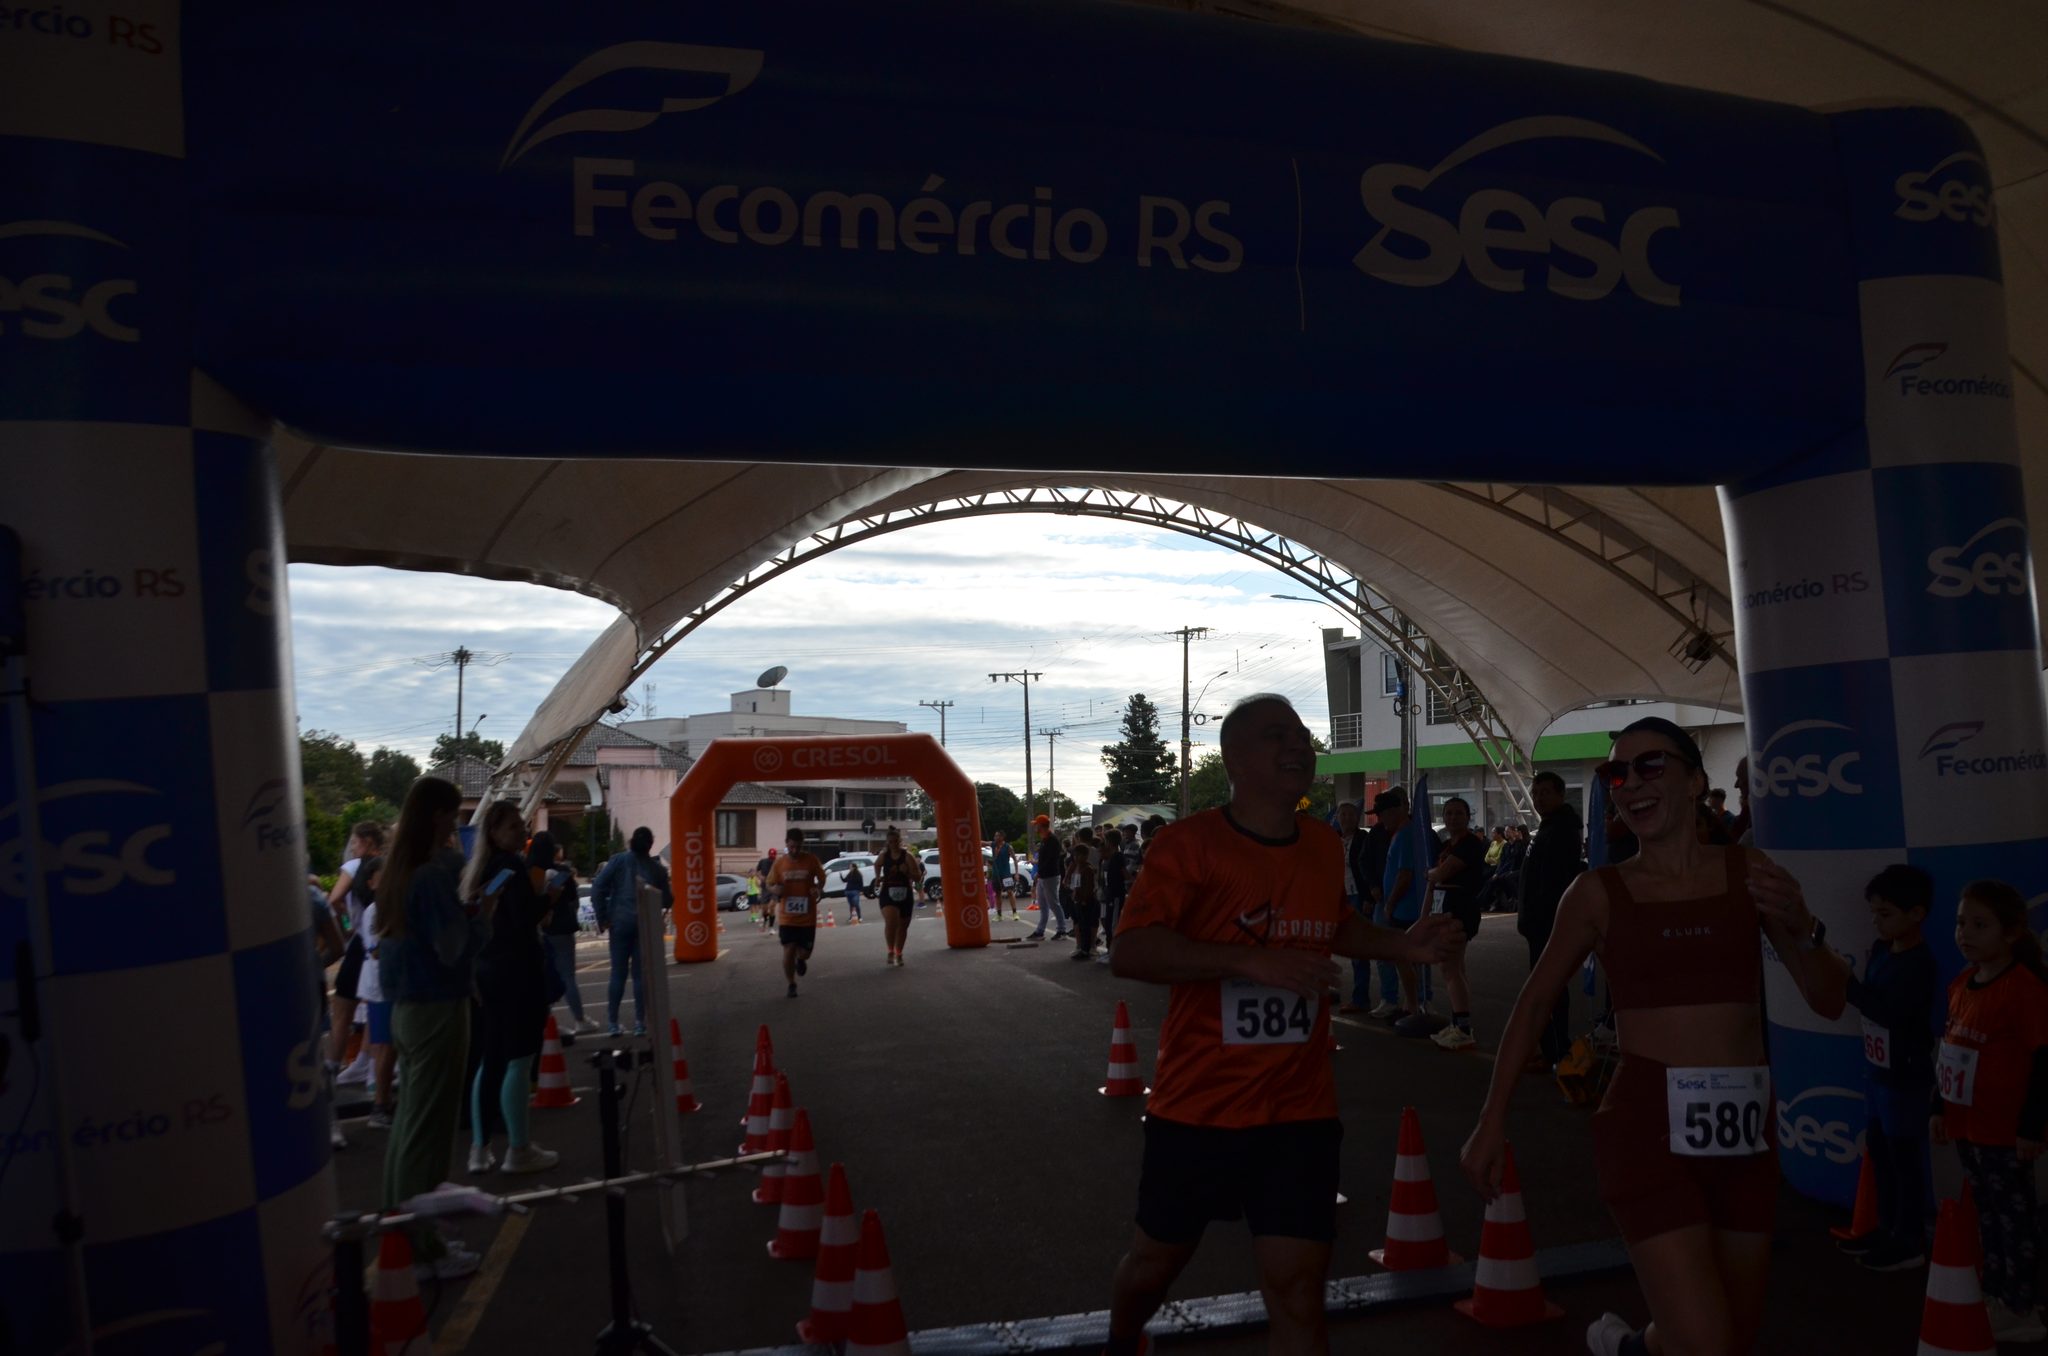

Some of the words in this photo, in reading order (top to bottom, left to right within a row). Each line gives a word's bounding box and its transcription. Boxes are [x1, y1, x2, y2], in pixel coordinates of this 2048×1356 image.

[110, 15, 162, 54] RS
[573, 157, 1108, 264] Fecomércio
[1138, 195, 1244, 273] RS
[1352, 162, 1682, 308] Sesc
[134, 568, 186, 598] RS
[1832, 571, 1869, 595] RS
[791, 744, 899, 769] CRESOL
[684, 824, 705, 915] CRESOL
[954, 810, 978, 898] CRESOL
[1236, 997, 1311, 1039] 584
[183, 1093, 234, 1131] RS
[1685, 1100, 1761, 1149] 580
